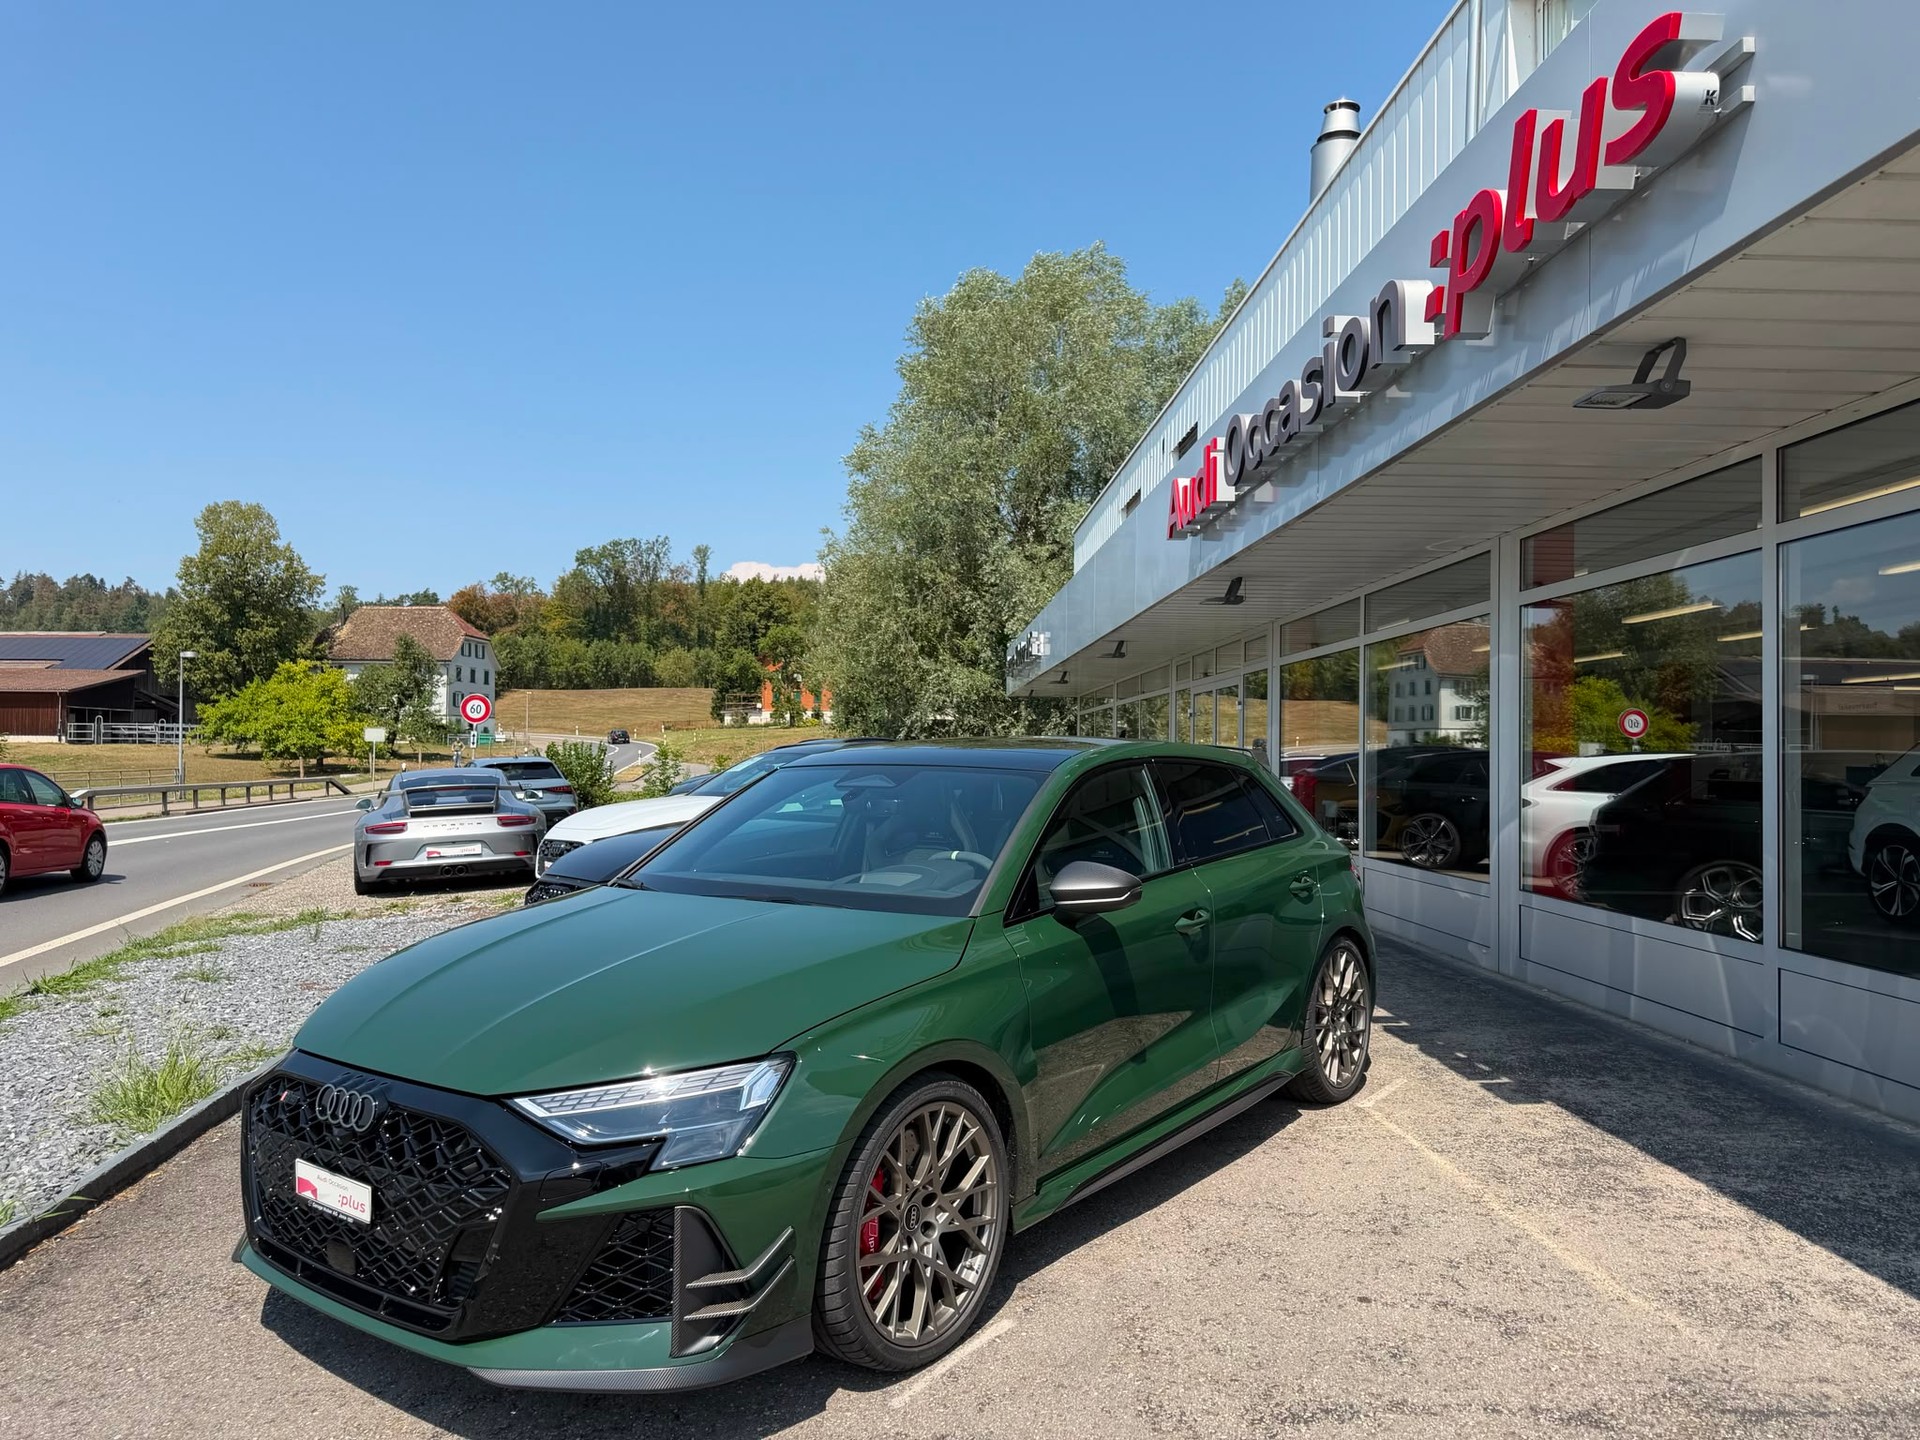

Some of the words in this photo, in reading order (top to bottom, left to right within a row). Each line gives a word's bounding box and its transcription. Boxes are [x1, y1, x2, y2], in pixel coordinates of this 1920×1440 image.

[1704, 89, 1718, 106] K
[1167, 437, 1217, 540] Audi
[1224, 280, 1407, 487] Occasion
[1425, 12, 1682, 340] :plus
[470, 704, 482, 714] 60
[338, 1193, 366, 1214] :plus
